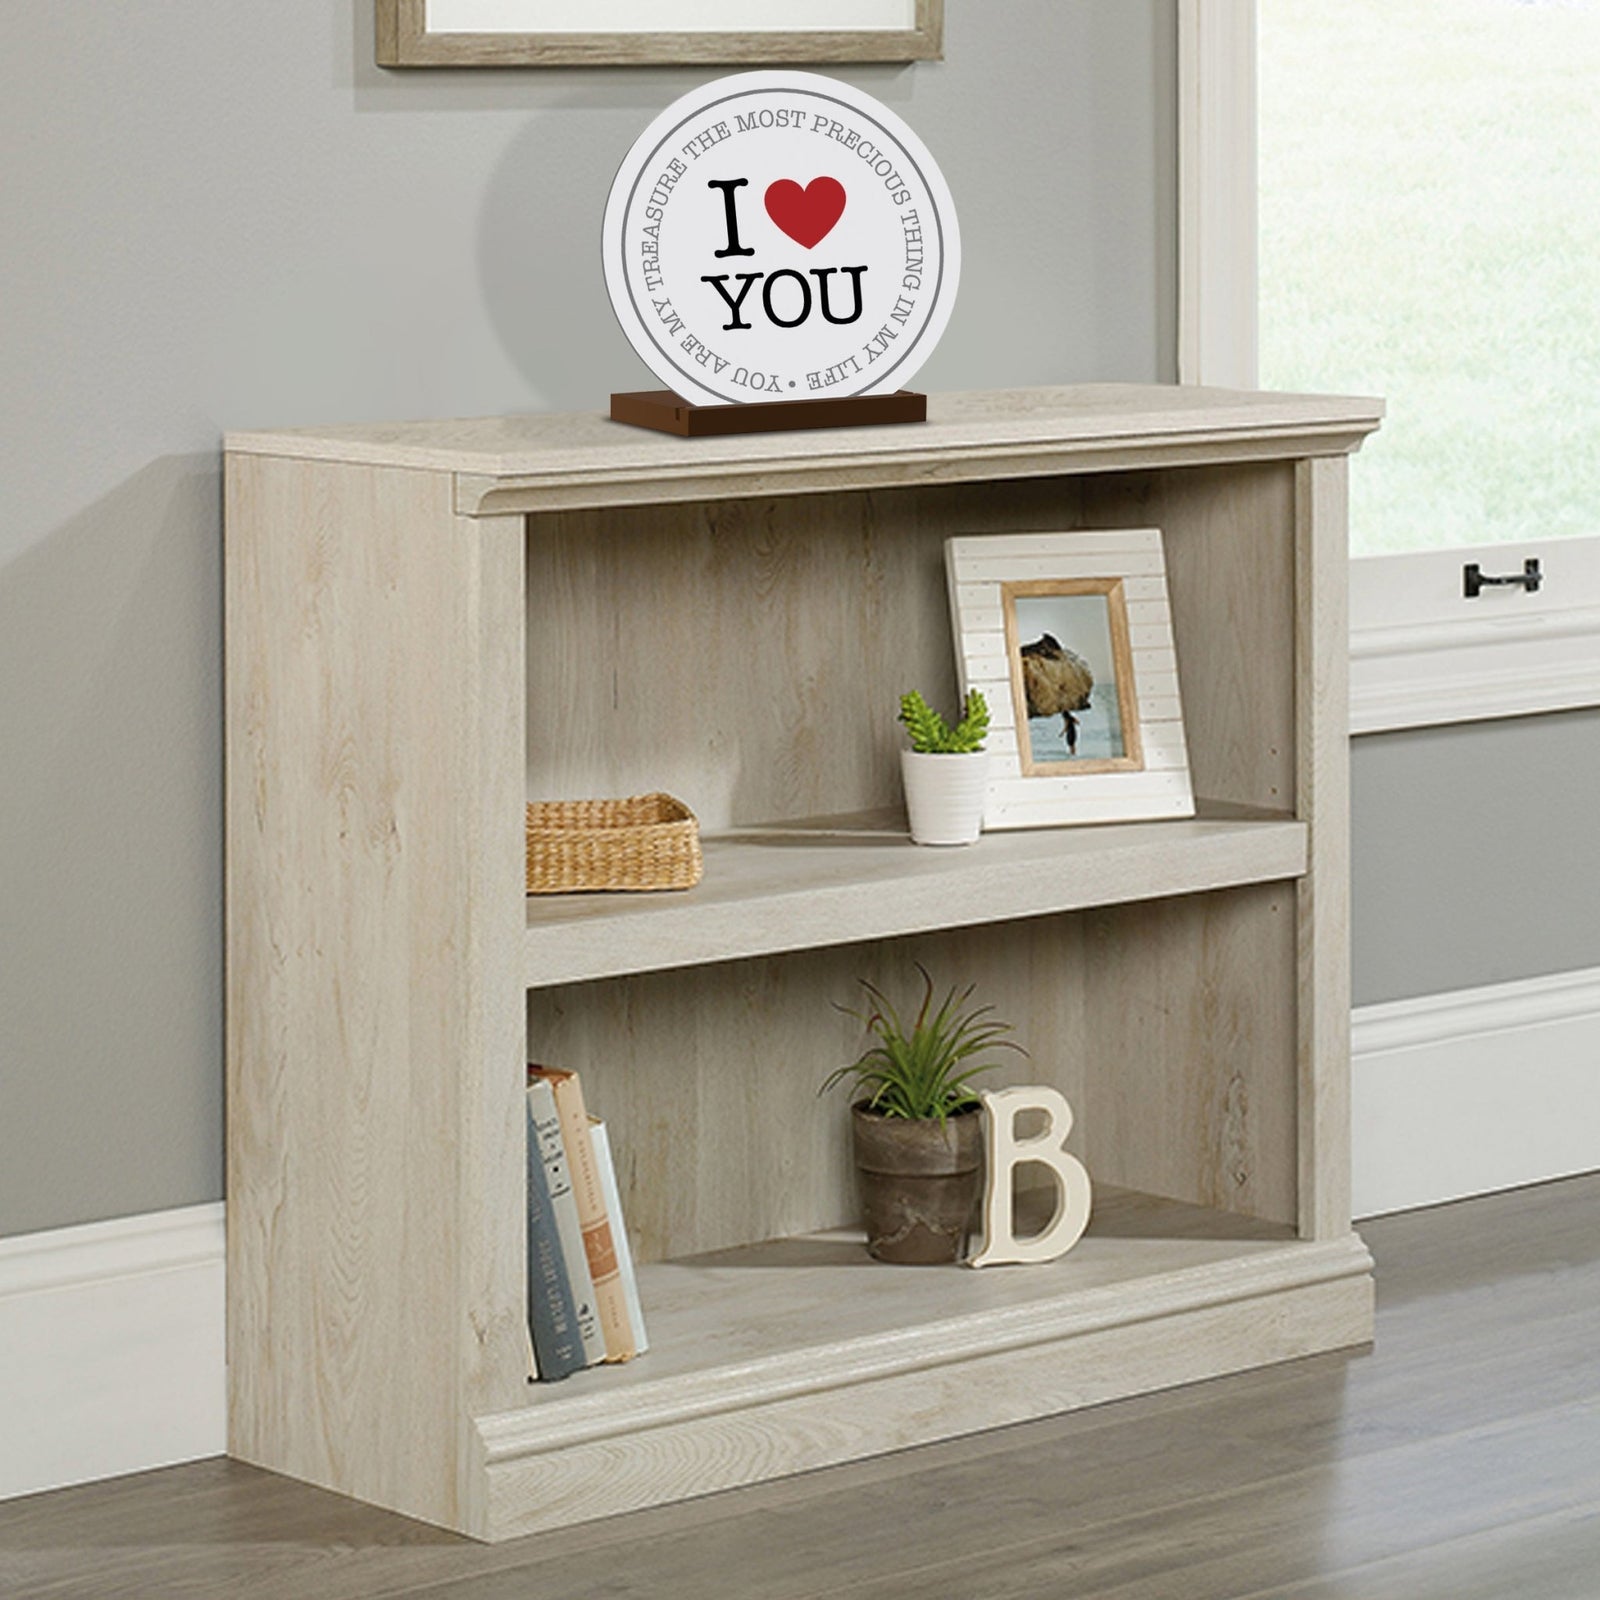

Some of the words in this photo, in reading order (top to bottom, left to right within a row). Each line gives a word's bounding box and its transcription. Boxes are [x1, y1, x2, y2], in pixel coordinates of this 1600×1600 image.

[682, 121, 732, 162] THE
[734, 109, 806, 134] MOST
[810, 114, 912, 206] PRECIOUS
[641, 157, 688, 291] TREASURE
[708, 178, 755, 258] I
[901, 209, 924, 291] THING
[652, 297, 686, 337] MY
[701, 265, 868, 331] YOU
[890, 294, 915, 327] IN
[680, 333, 731, 374] ARE
[862, 324, 900, 364] MY
[730, 369, 783, 393] YOU
[806, 355, 863, 391] LIFE
[967, 1085, 1092, 1268] B
